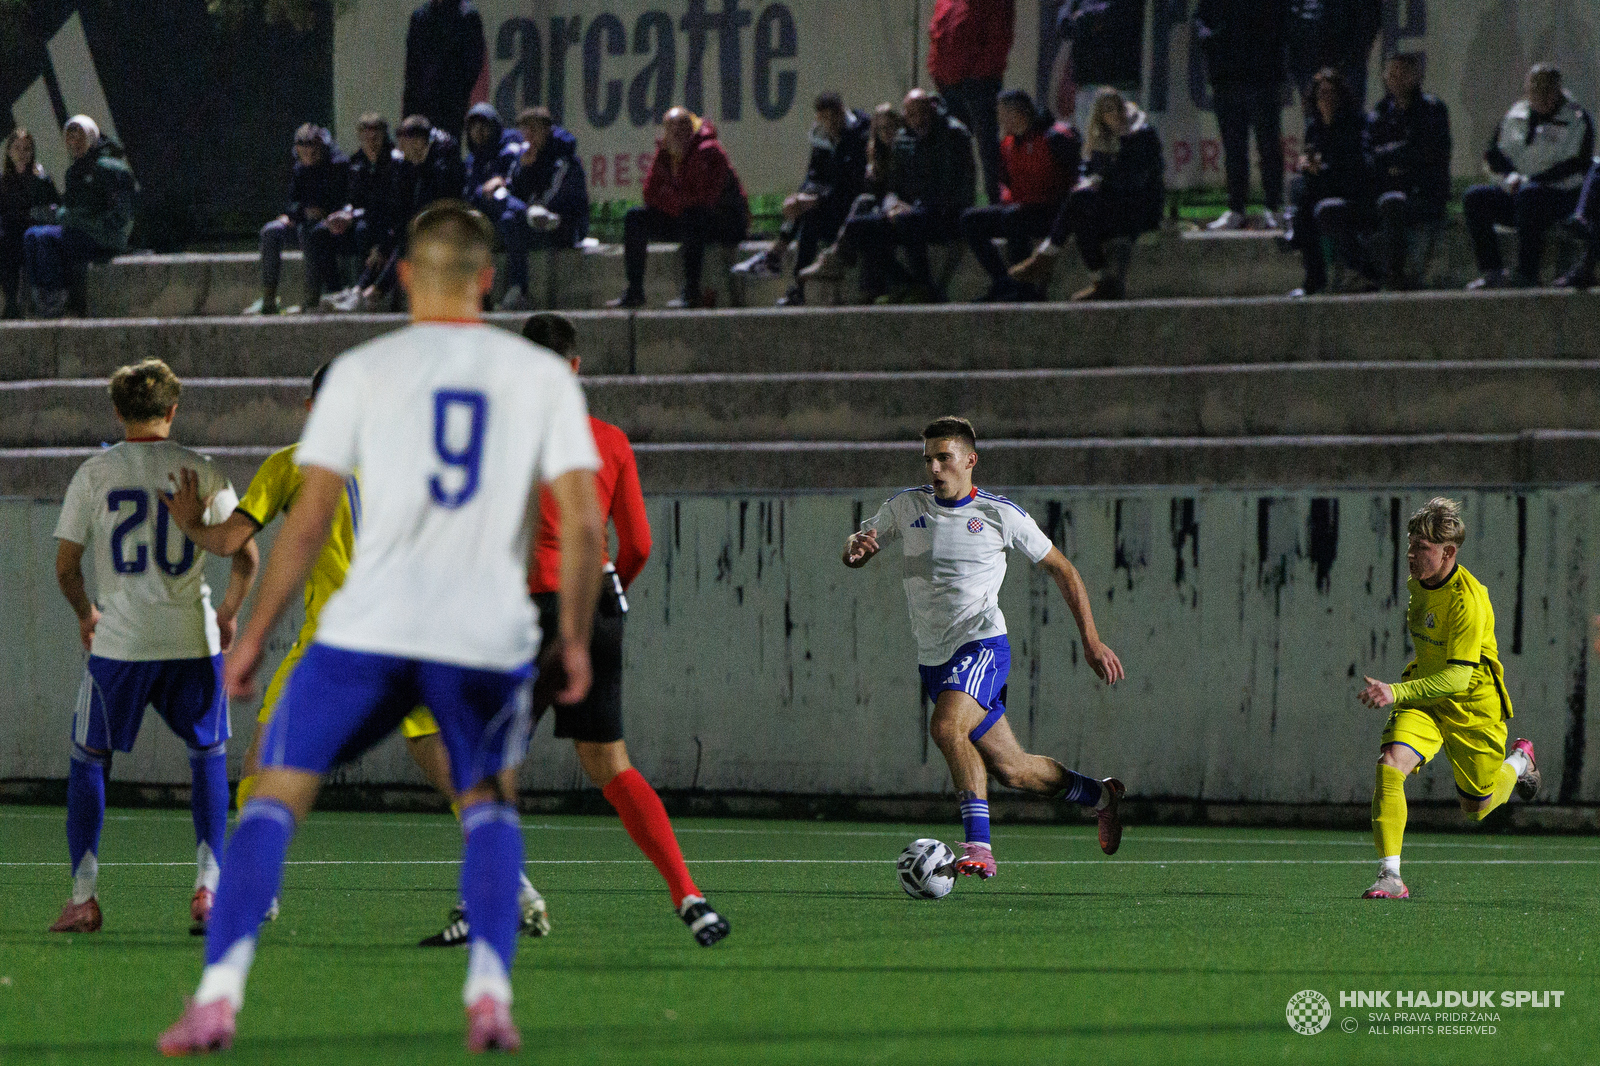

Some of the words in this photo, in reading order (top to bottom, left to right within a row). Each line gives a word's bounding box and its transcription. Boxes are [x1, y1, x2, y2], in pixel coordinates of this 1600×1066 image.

[469, 0, 798, 128] arcaffe
[429, 388, 489, 510] 9
[107, 488, 196, 576] 20
[952, 655, 973, 674] 3
